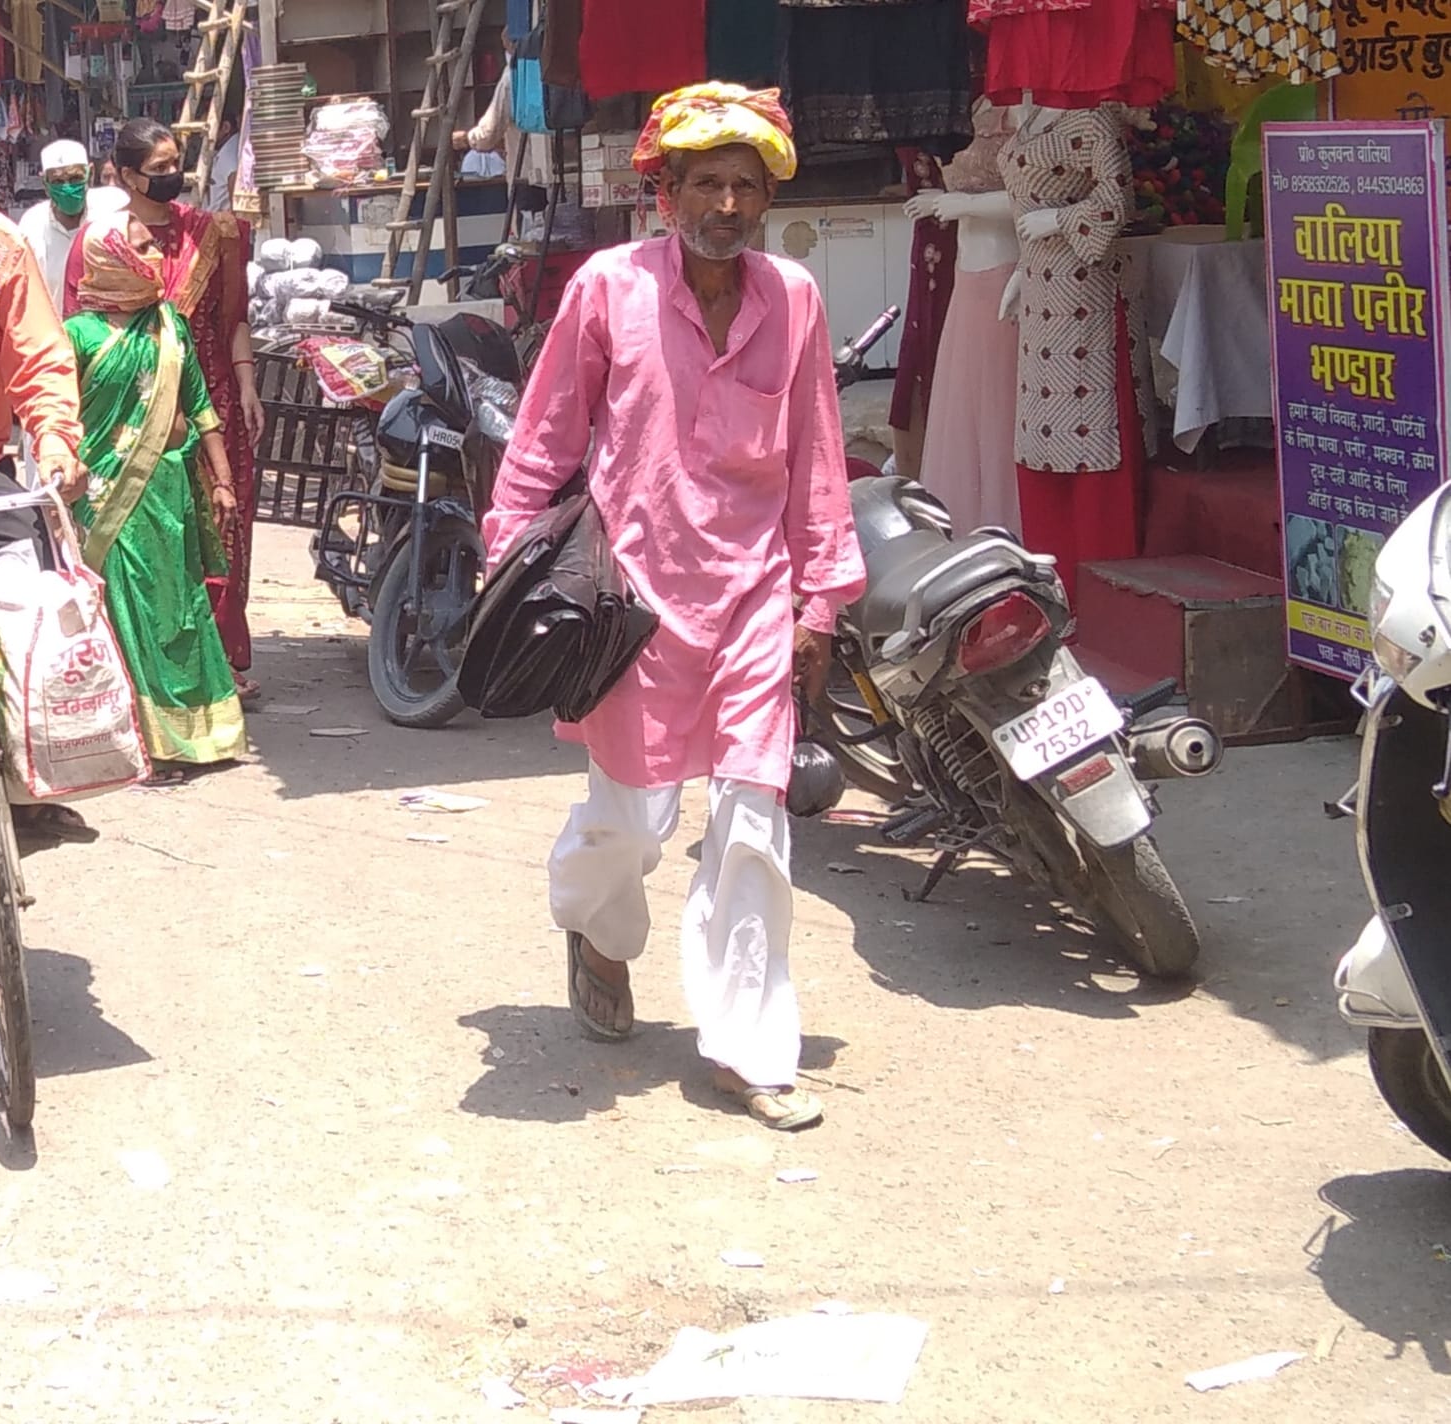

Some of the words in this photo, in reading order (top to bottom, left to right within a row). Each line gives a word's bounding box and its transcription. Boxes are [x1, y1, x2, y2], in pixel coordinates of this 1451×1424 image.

[1317, 146, 1354, 169] कुलवन्त
[1356, 139, 1391, 163] वालिया
[1293, 202, 1402, 266] वालिया
[1278, 278, 1344, 328] मावा
[1351, 271, 1426, 336] पनीर
[1310, 344, 1395, 400] भण्डार
[1287, 399, 1308, 421] हमारे
[1284, 424, 1295, 446] के
[1296, 426, 1317, 456] लिए
[1348, 467, 1372, 492] आदि
[1372, 470, 1385, 493] के
[1386, 471, 1409, 502] लिए
[1010, 693, 1085, 744] UP19D
[1034, 719, 1097, 763] 7532
